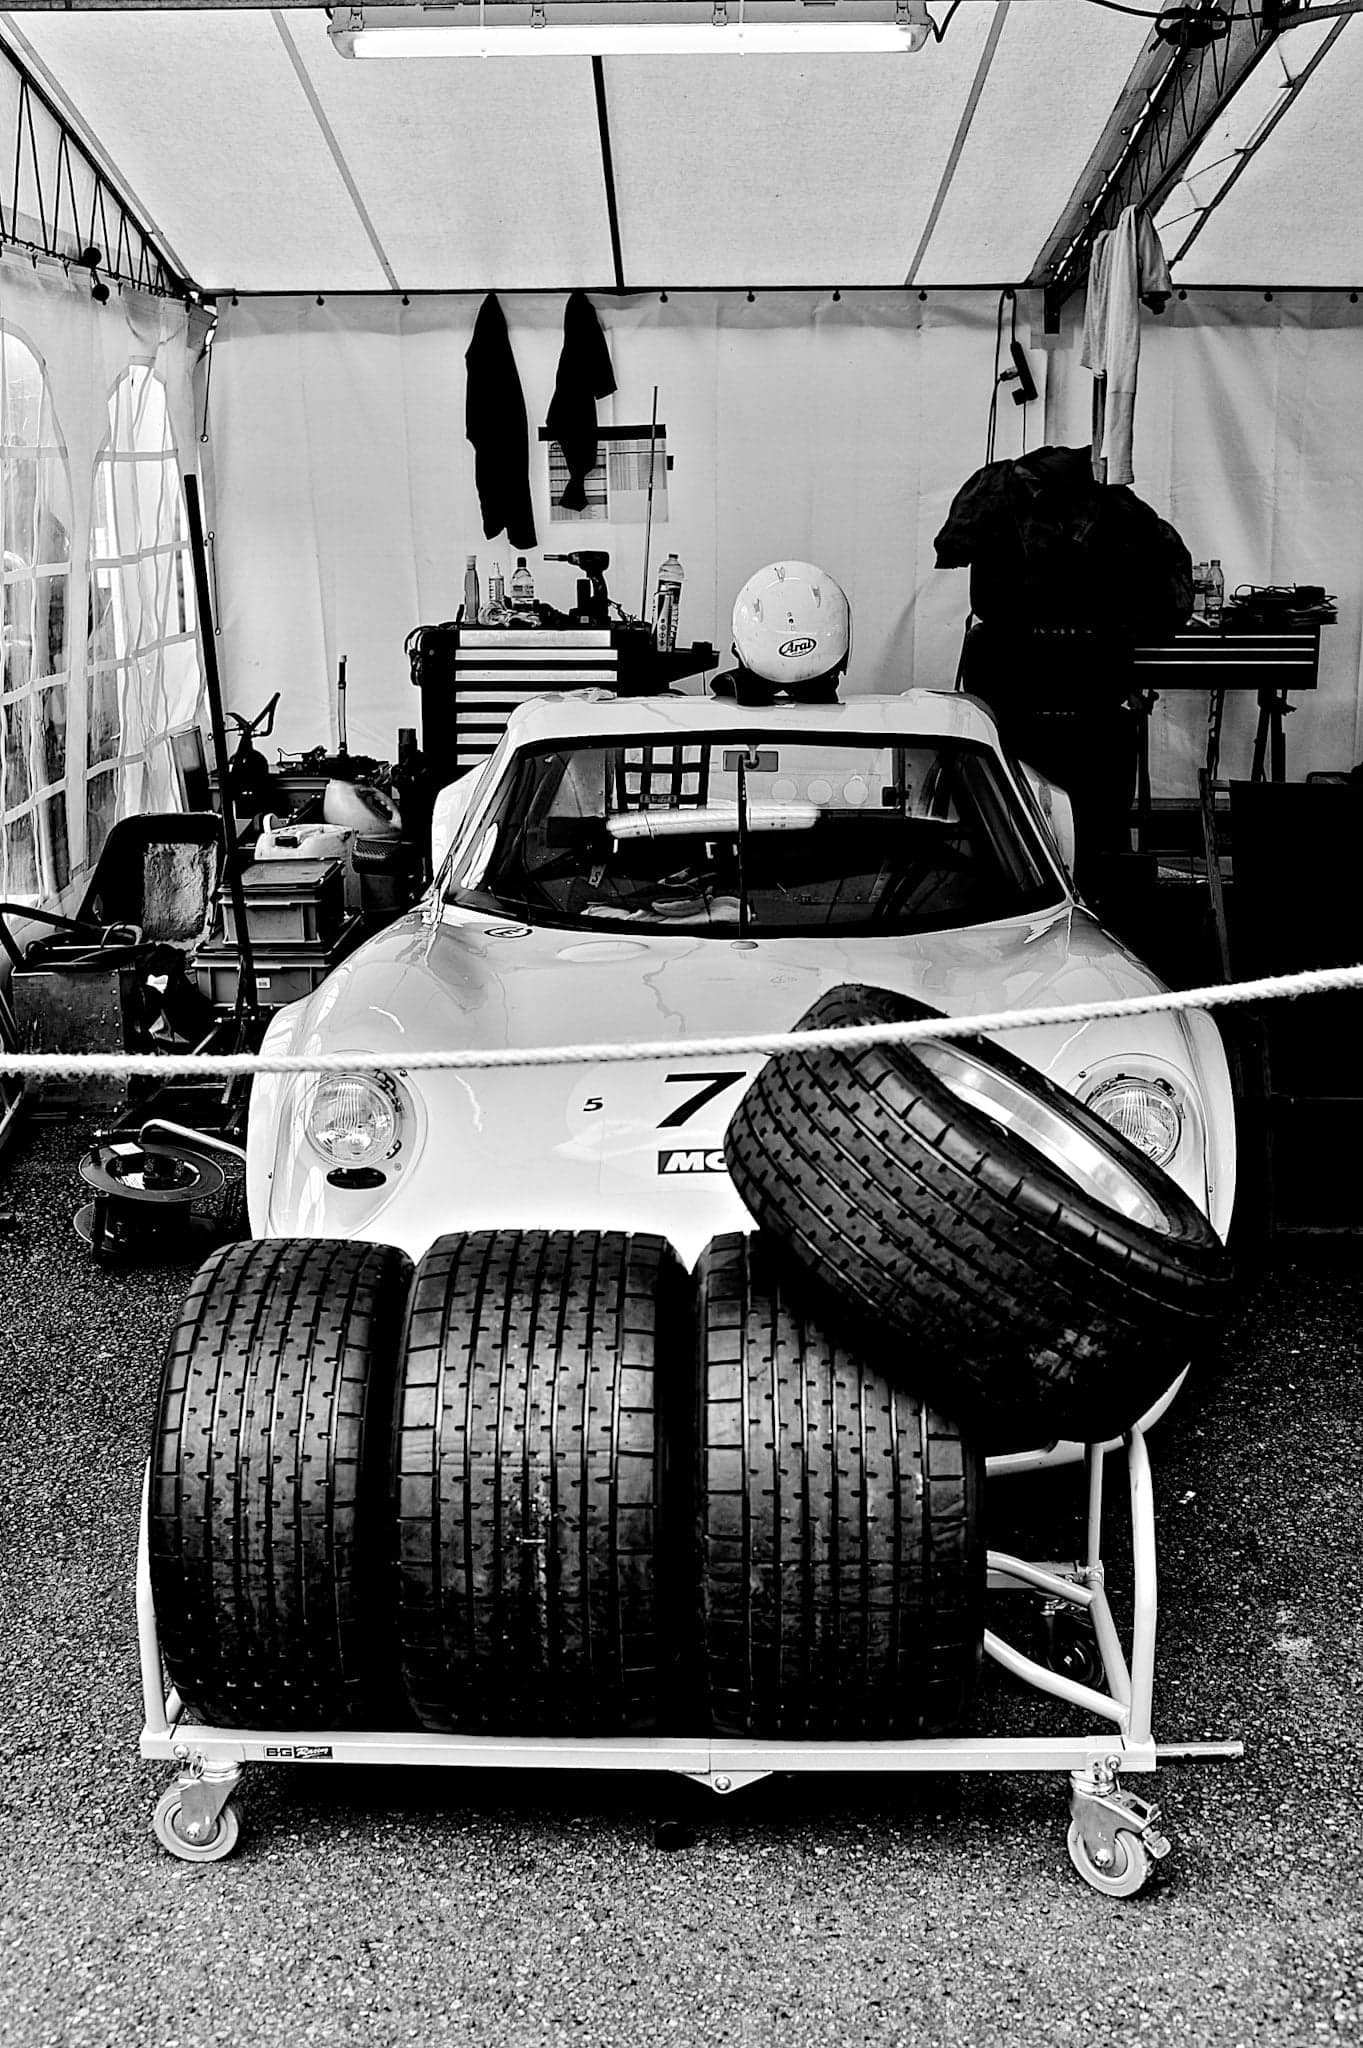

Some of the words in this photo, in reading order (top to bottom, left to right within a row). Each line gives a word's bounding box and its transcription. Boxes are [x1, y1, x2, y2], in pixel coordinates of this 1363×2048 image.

[783, 639, 811, 652] Arai
[583, 1097, 604, 1112] 5
[656, 1072, 747, 1129] 7
